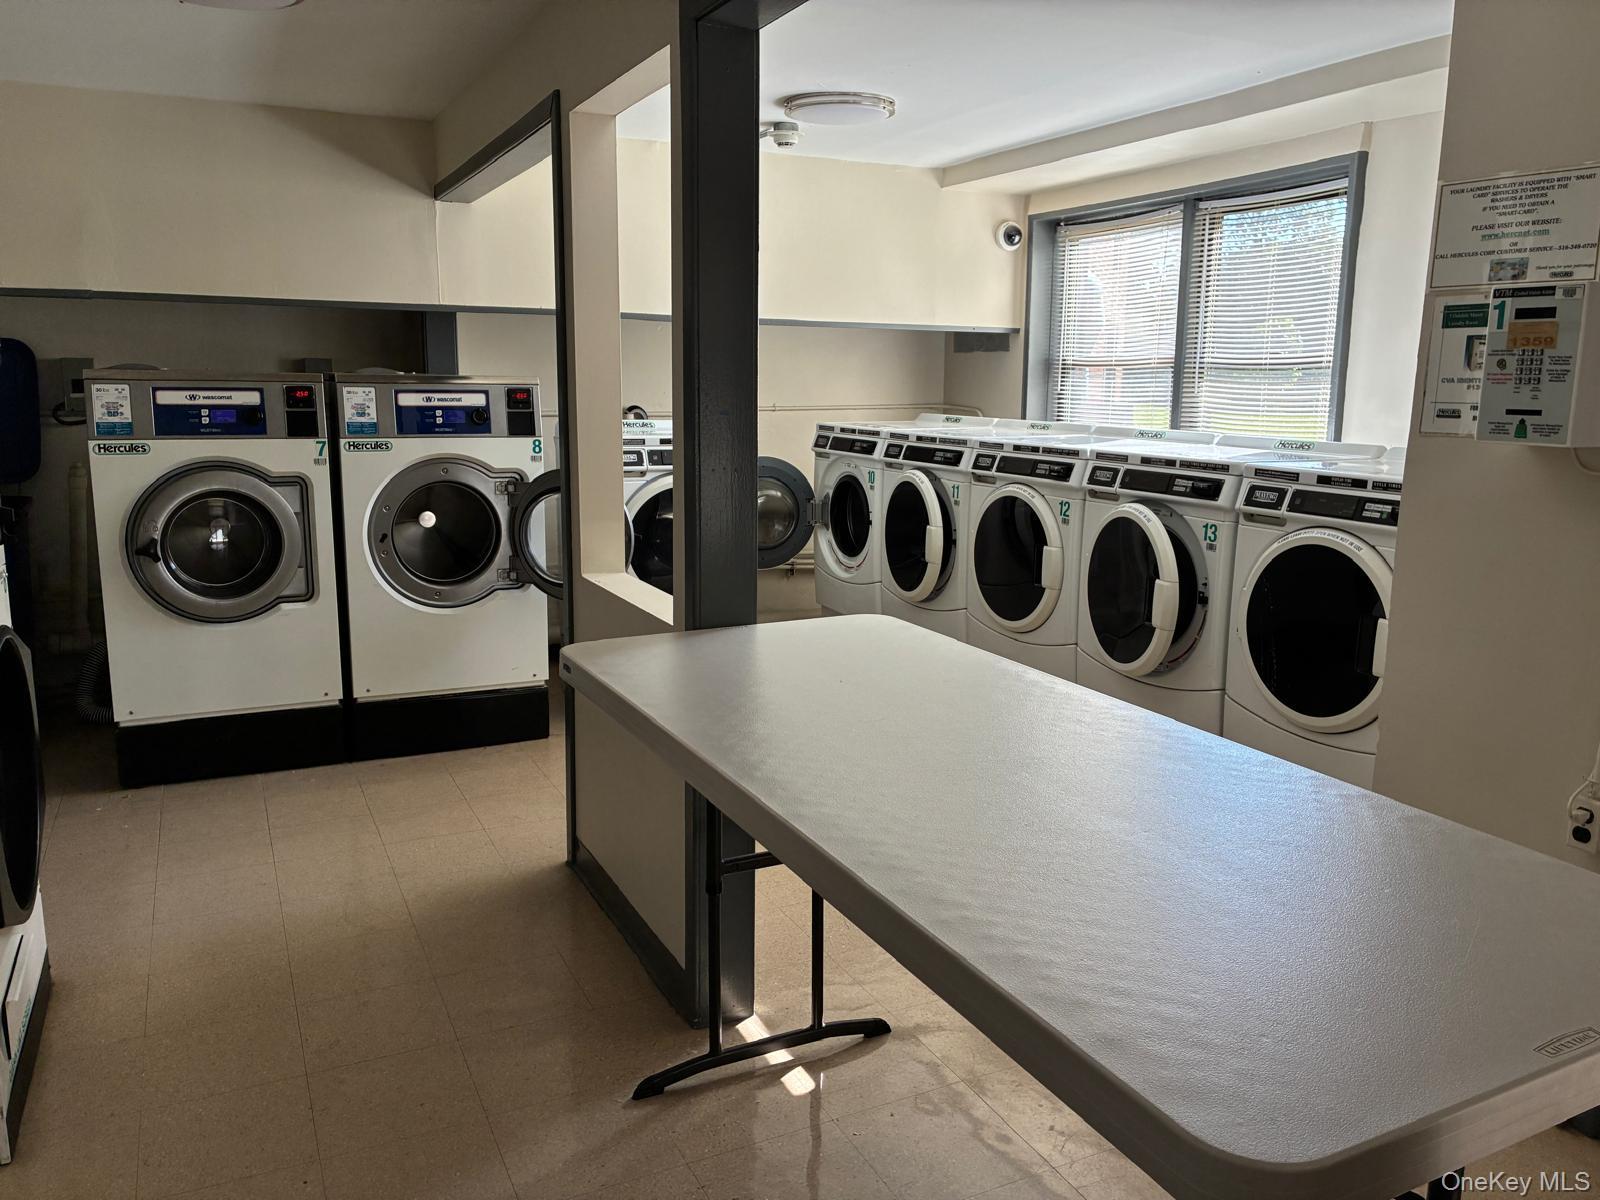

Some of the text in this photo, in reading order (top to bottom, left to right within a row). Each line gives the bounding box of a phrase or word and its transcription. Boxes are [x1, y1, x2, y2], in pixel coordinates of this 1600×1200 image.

[1466, 185, 1492, 193] LAUNDRY
[1492, 182, 1516, 190] FACILITY
[1524, 178, 1555, 187] EQUIPPED
[1556, 175, 1572, 183] WITH
[1491, 188, 1519, 197] SERVICES
[1529, 184, 1557, 193] OPERATE
[1524, 192, 1549, 200] DRYERS
[1527, 200, 1549, 208] OBTAIN
[1471, 217, 1562, 232] PLEASE VISIT OUR WEBSITE:
[1450, 250, 1479, 259] HERCULES
[1496, 247, 1527, 255] CUSTOMER
[1493, 300, 1506, 330] 1
[1510, 336, 1554, 347] 1359
[1137, 430, 1163, 438] Hercules
[97, 443, 147, 454] Hercules
[315, 440, 327, 456] 7
[347, 441, 390, 451] Hercules
[532, 439, 542, 454] 8
[1278, 440, 1313, 450] Hercules
[868, 470, 876, 484] 10
[952, 484, 960, 499] 11
[1059, 500, 1071, 517] 12
[1203, 522, 1218, 542] 13
